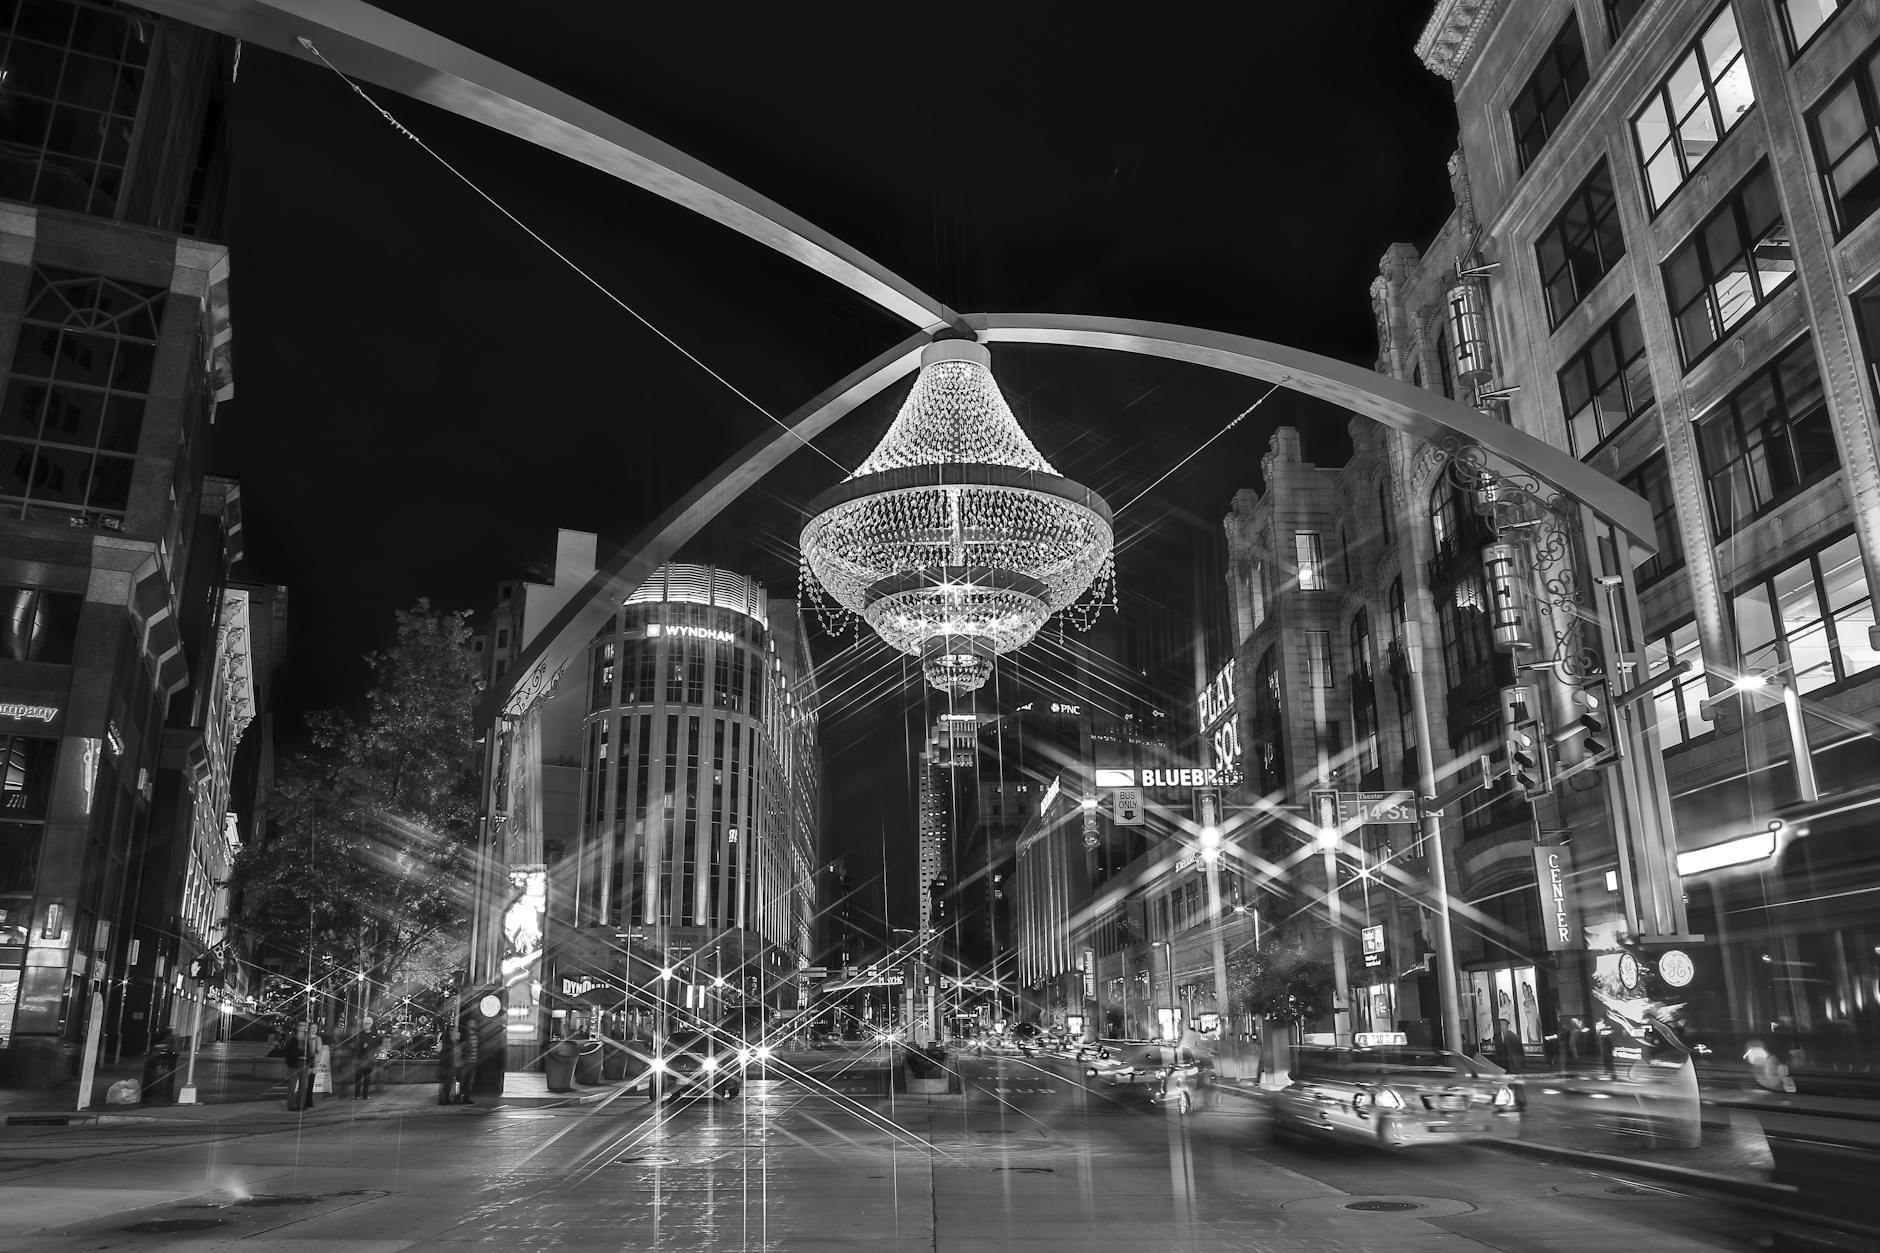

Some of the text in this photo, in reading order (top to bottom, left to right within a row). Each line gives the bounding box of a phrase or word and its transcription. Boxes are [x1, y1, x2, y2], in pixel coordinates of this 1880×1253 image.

[665, 625, 735, 643] WYNDHAM
[1198, 657, 1235, 734] PLAY
[0, 703, 58, 723] mpany
[1060, 703, 1081, 715] PNC
[1120, 791, 1136, 800] BUS
[1118, 800, 1139, 809] ONLY
[1360, 804, 1382, 820] 14
[1387, 805, 1409, 820] St
[1548, 854, 1570, 942] CENTER
